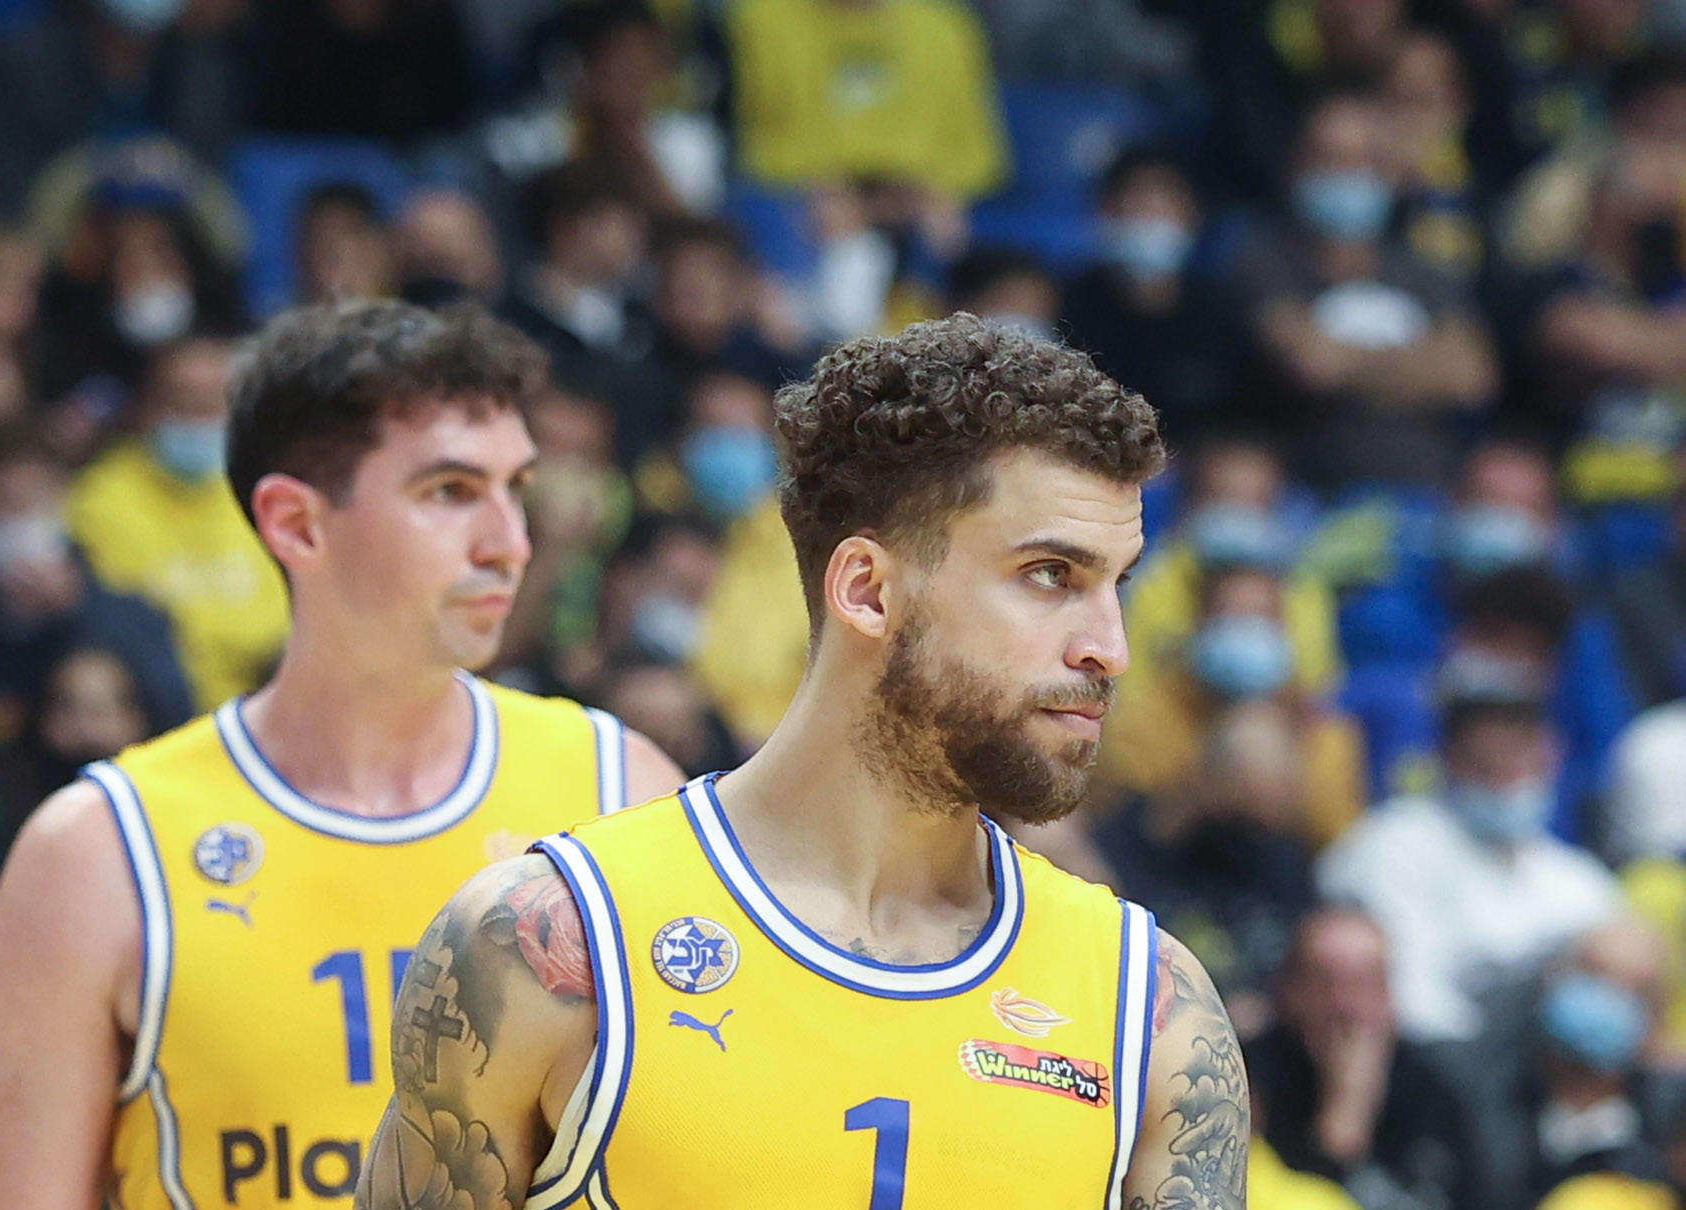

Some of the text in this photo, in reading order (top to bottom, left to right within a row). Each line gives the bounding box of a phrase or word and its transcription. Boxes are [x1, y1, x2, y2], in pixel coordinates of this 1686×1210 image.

[976, 1050, 1098, 1098] Winner סל
[1040, 1057, 1073, 1077] ליגת
[219, 1125, 362, 1205] Pla
